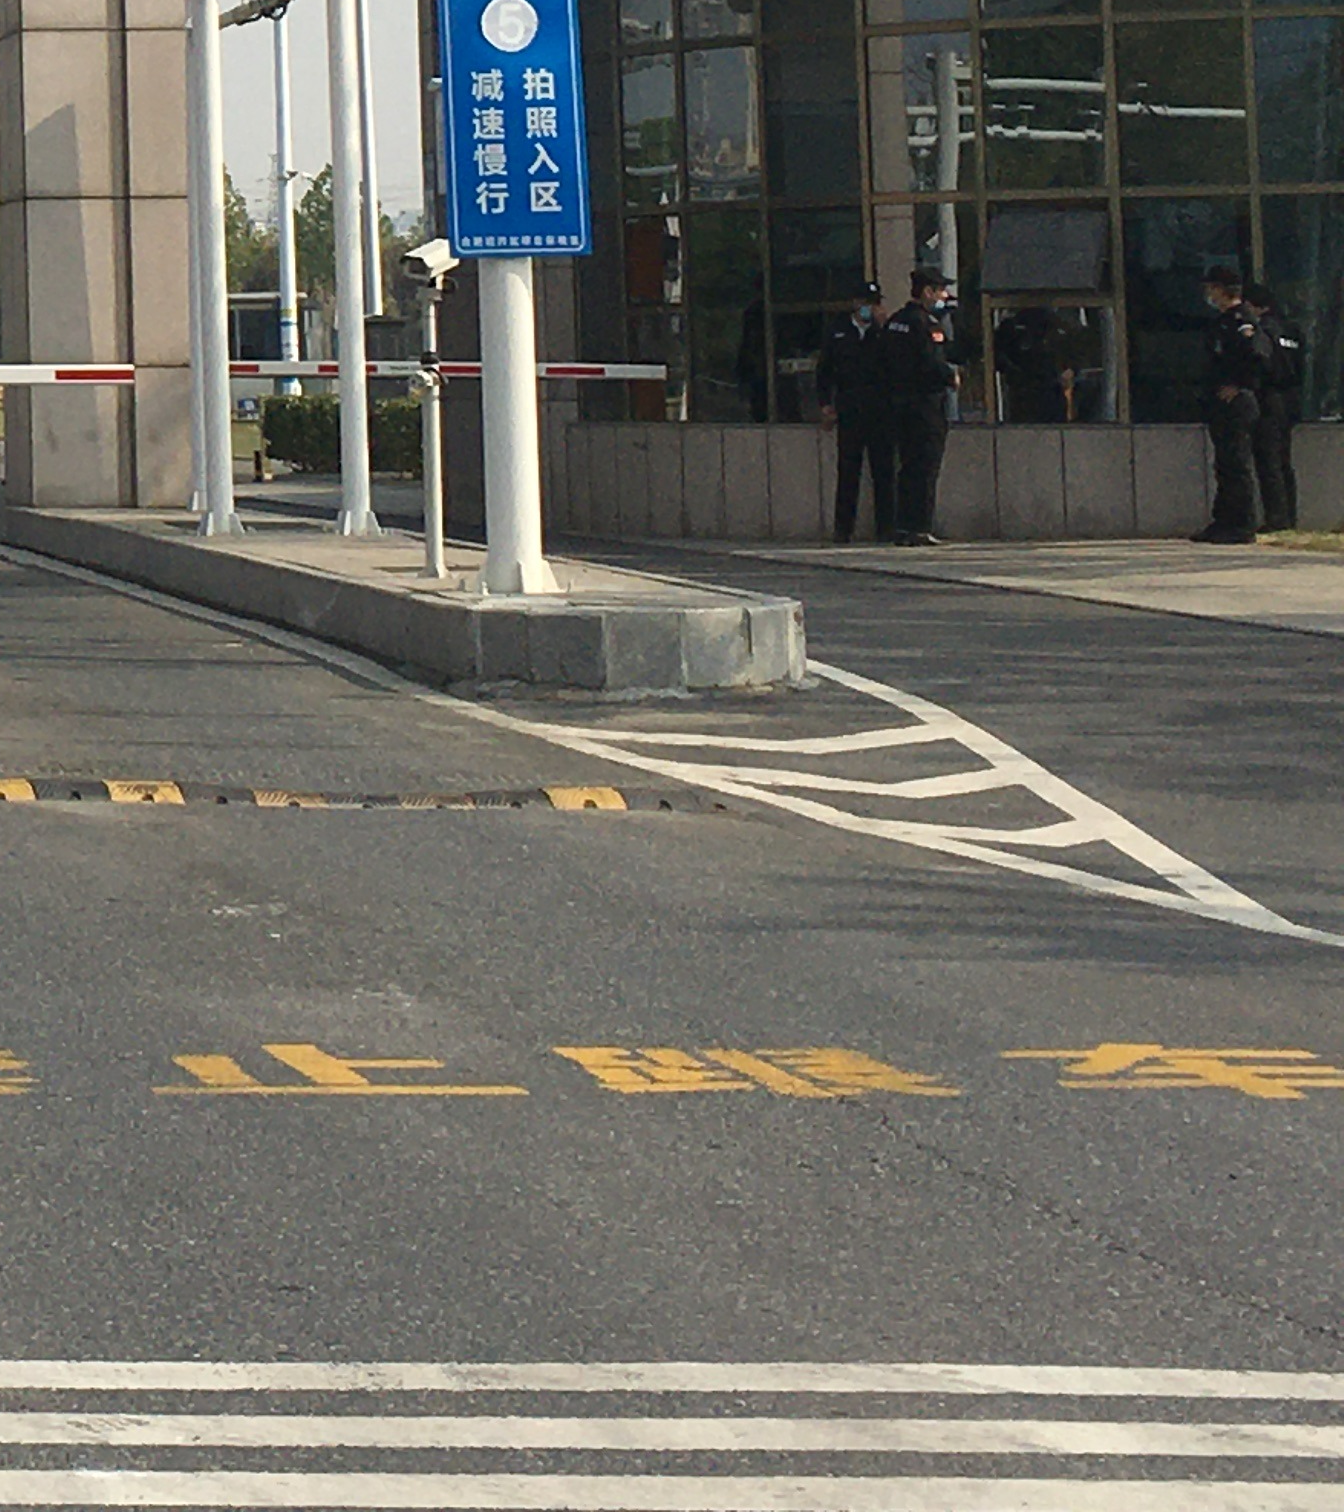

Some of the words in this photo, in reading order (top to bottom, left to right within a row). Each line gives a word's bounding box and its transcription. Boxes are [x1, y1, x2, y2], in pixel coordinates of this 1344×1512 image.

[498, 2, 525, 44] 5
[470, 68, 510, 215] 减速慢行
[522, 67, 563, 213] 拍照入区
